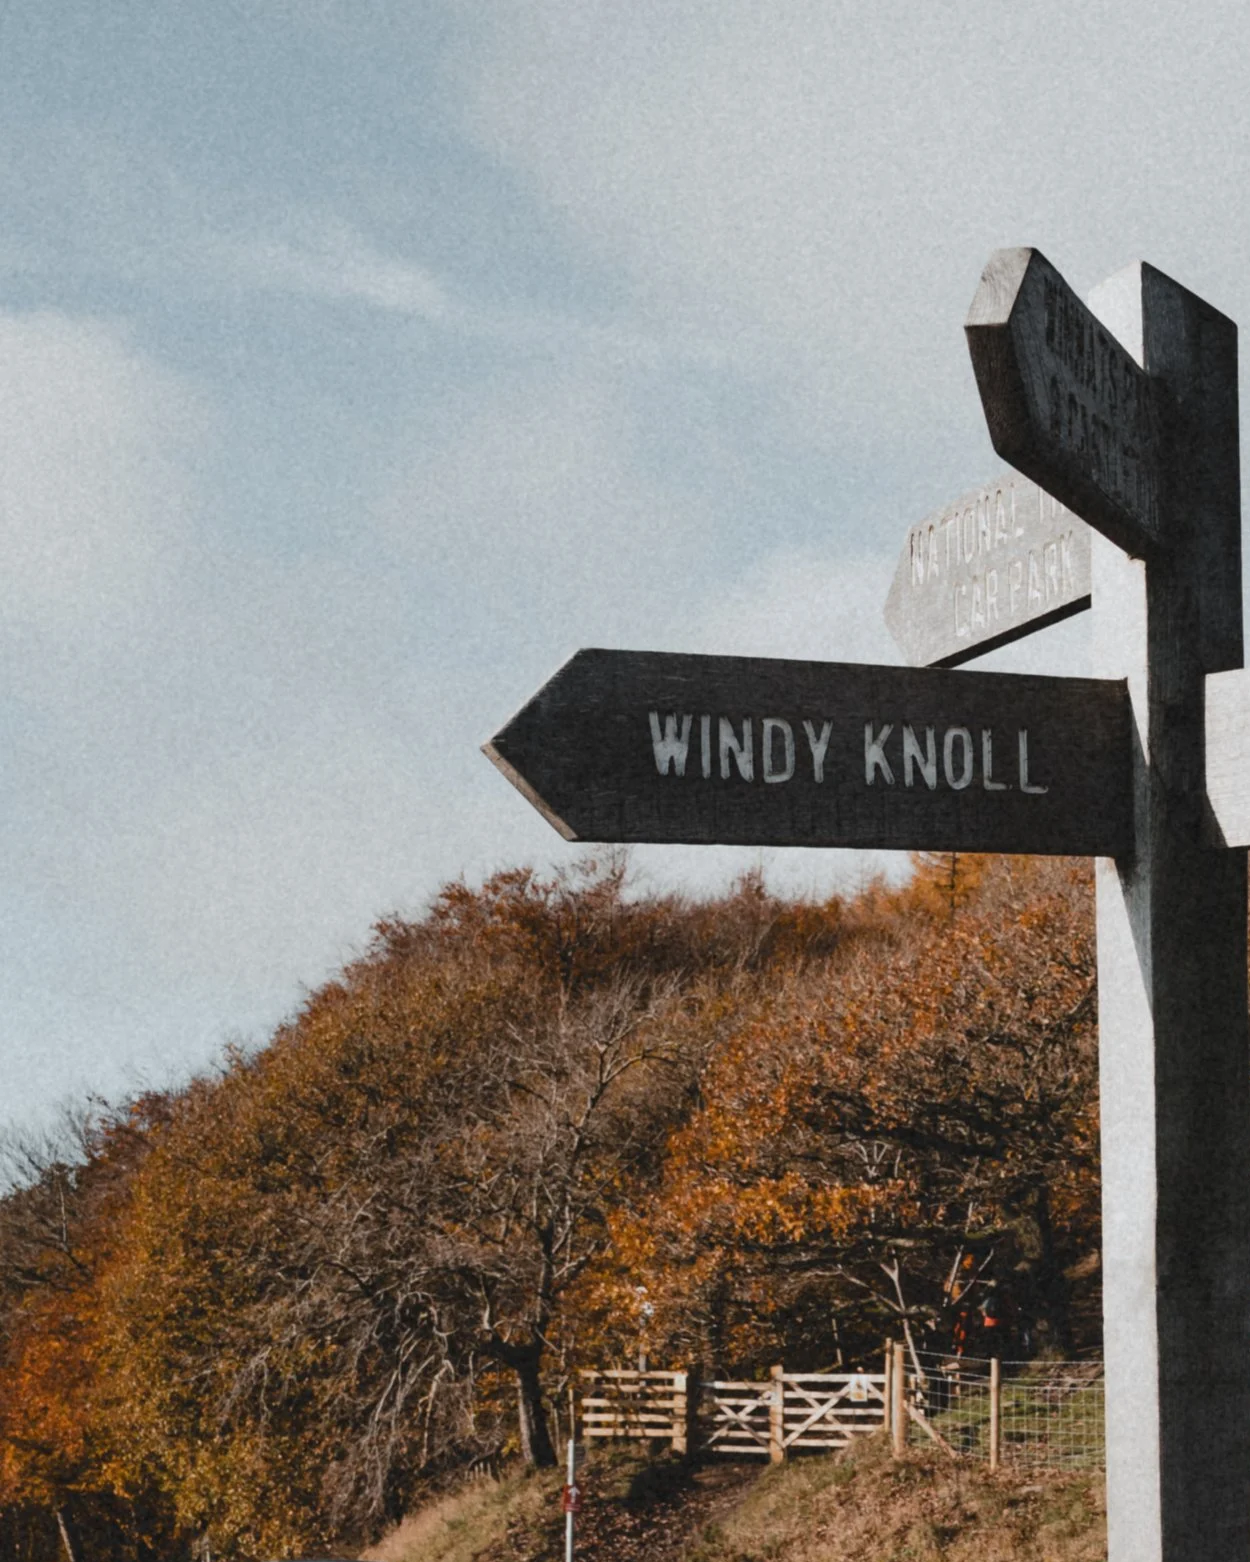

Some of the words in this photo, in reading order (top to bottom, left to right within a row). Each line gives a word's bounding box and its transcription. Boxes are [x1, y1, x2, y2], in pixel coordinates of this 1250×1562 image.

[909, 482, 1026, 586] NATIONAL
[954, 567, 1000, 638] CAR
[1008, 530, 1074, 617] PARK
[648, 710, 834, 784] WINDY
[864, 720, 1049, 795] KNOLL
